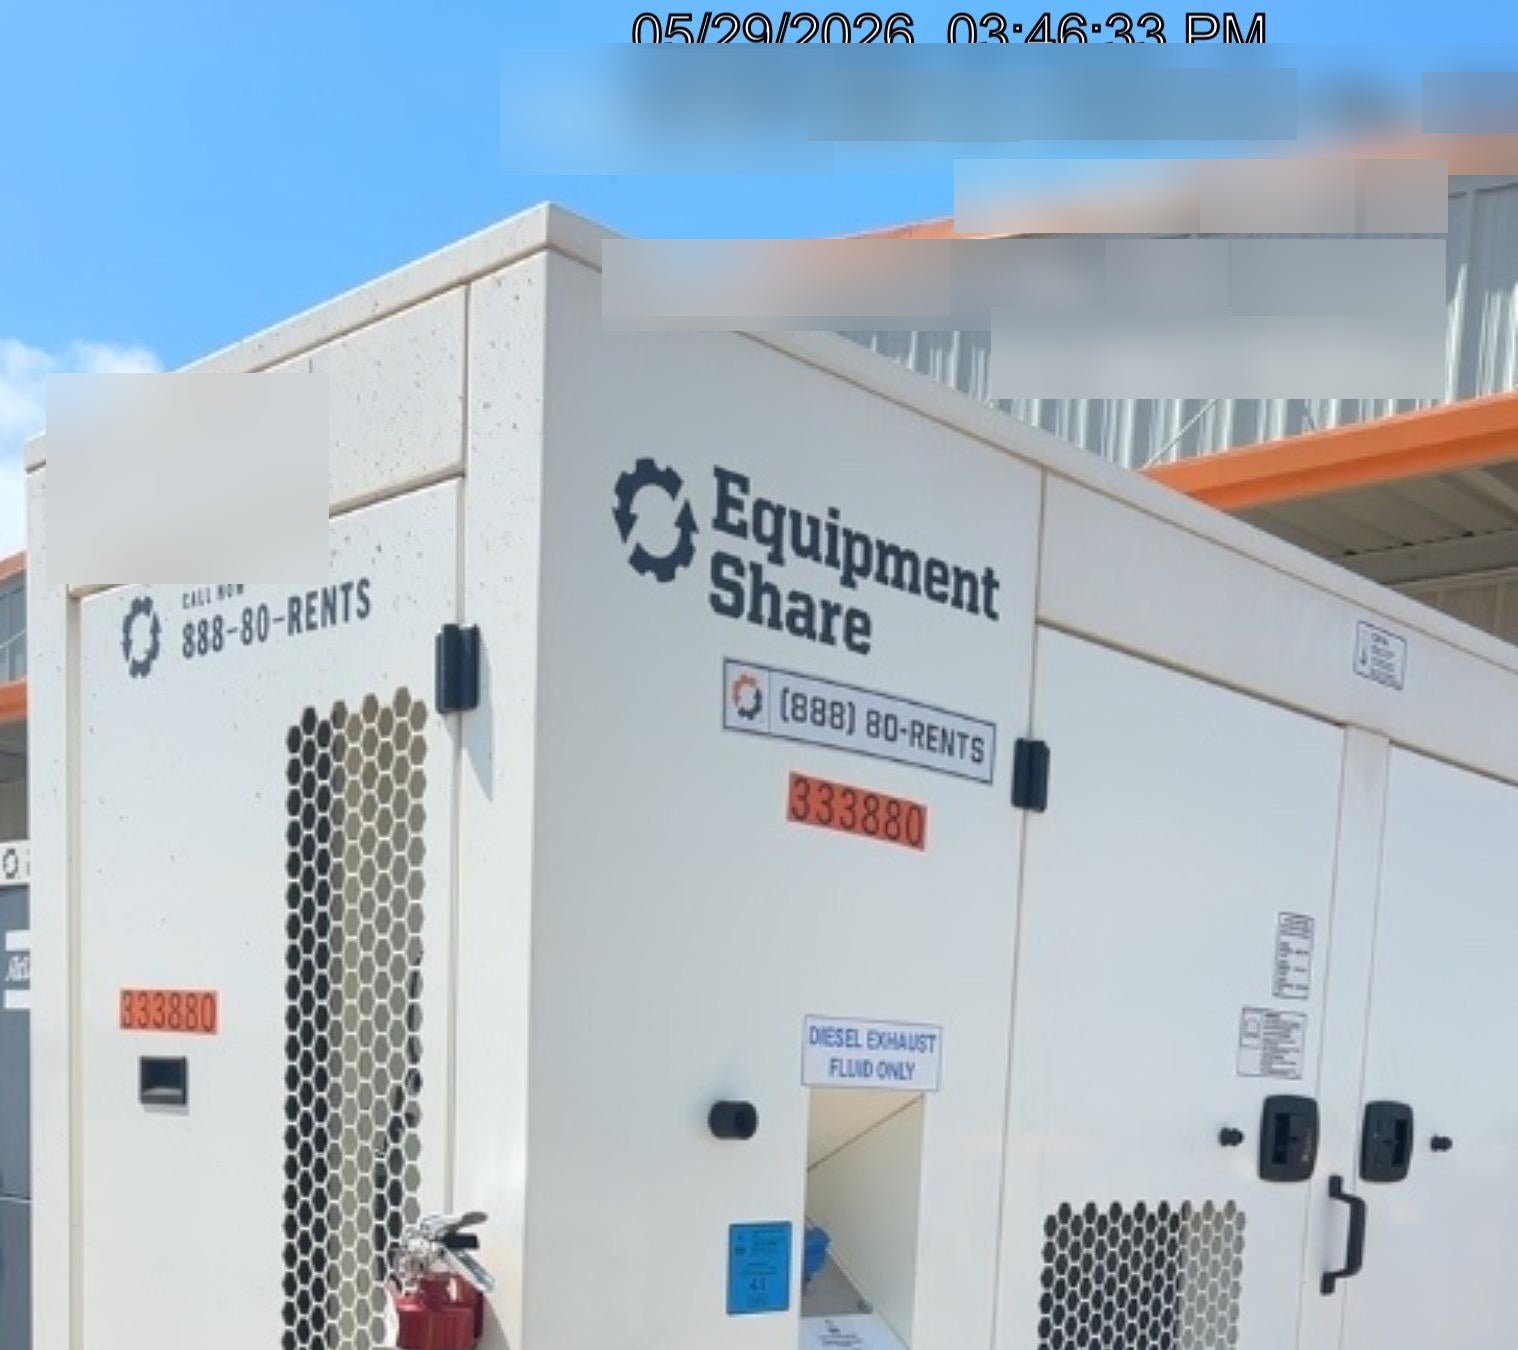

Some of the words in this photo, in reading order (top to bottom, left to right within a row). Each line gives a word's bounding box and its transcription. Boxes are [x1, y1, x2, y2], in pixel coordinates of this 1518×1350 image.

[713, 465, 1000, 621] Equipment
[182, 578, 371, 659] 888-80-RENTS
[183, 588, 211, 609] CALL
[709, 551, 872, 655] Share
[780, 687, 855, 735] (888)
[866, 711, 985, 764] 80-RENTS
[789, 776, 924, 846] 333880
[121, 991, 217, 1033] 333880
[809, 1025, 862, 1048] DIESEL
[867, 1029, 937, 1053] EXHAUST
[829, 1057, 873, 1078] FLUID
[877, 1061, 916, 1081] ONLY
